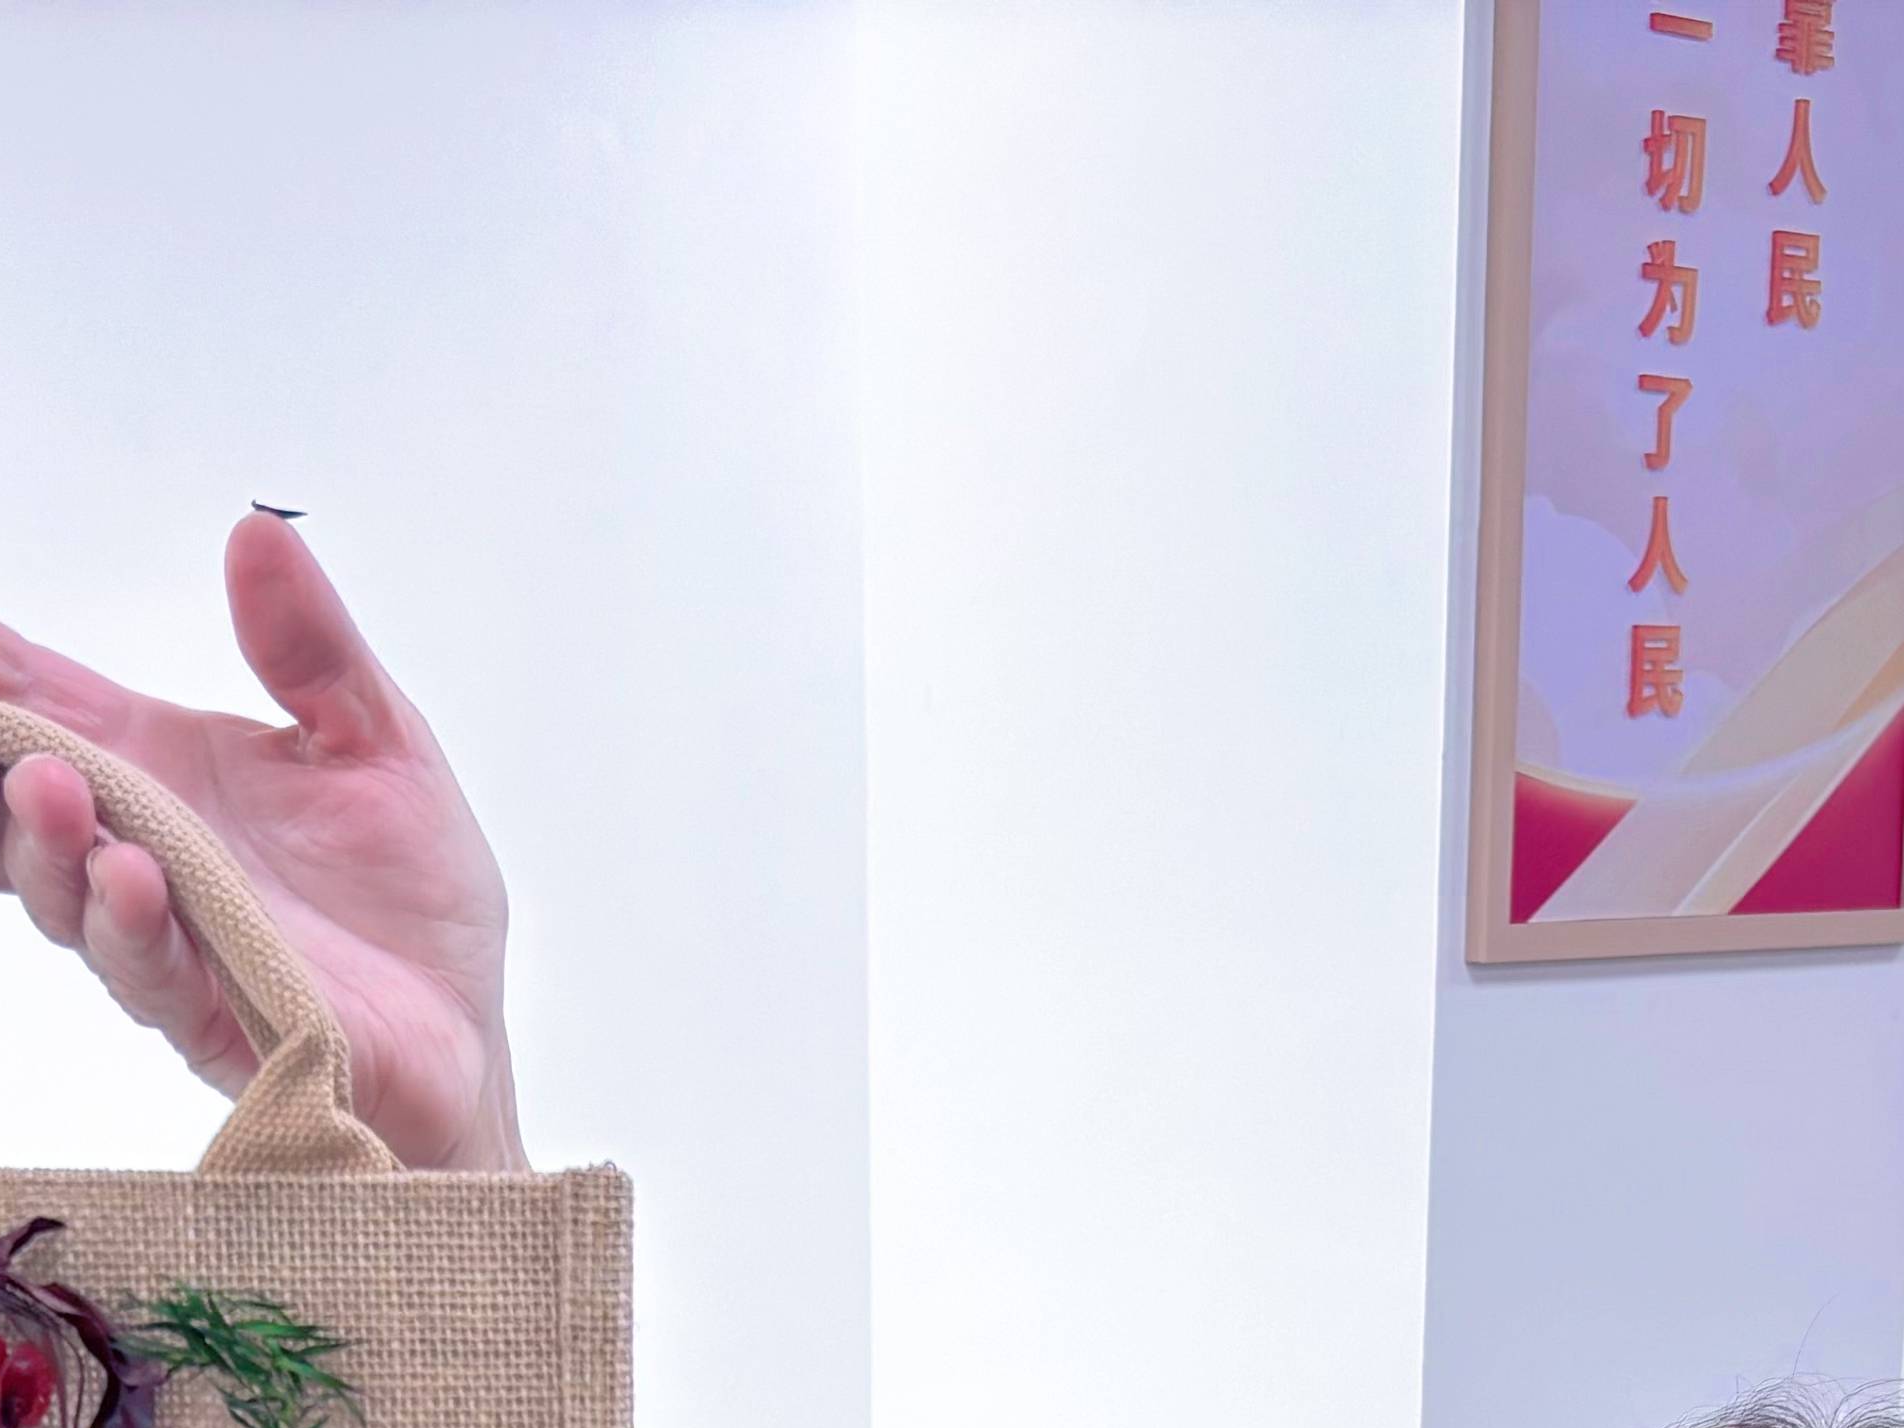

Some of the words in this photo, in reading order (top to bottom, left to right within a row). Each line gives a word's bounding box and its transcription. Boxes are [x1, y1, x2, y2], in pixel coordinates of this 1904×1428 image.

[1626, 10, 1714, 720] 一切为了人民
